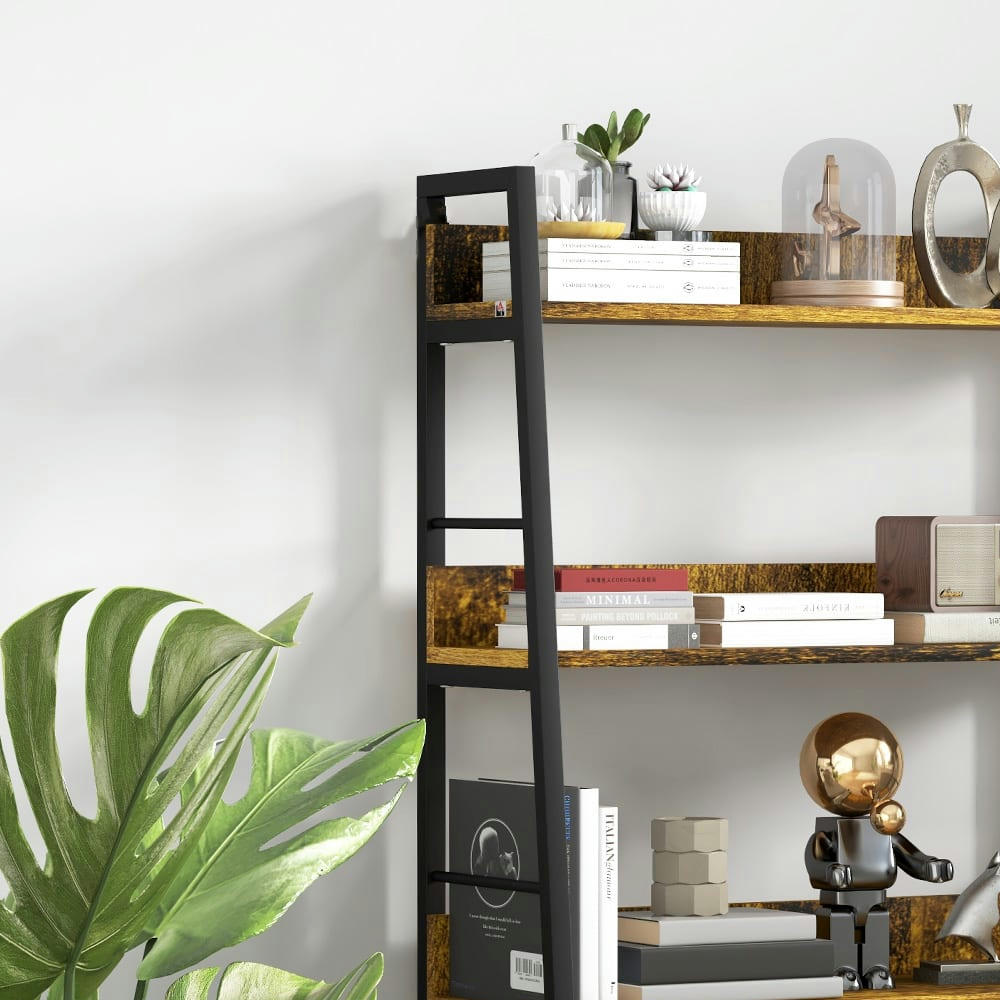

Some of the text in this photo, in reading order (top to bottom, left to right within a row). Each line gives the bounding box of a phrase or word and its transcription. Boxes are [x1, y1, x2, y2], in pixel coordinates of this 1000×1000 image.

[586, 594, 651, 605] MINIMAL
[581, 612, 615, 622] PAINTING
[616, 612, 645, 621] BEYOND
[646, 611, 679, 620] POLLOCK
[605, 815, 615, 861] ITALIAN
